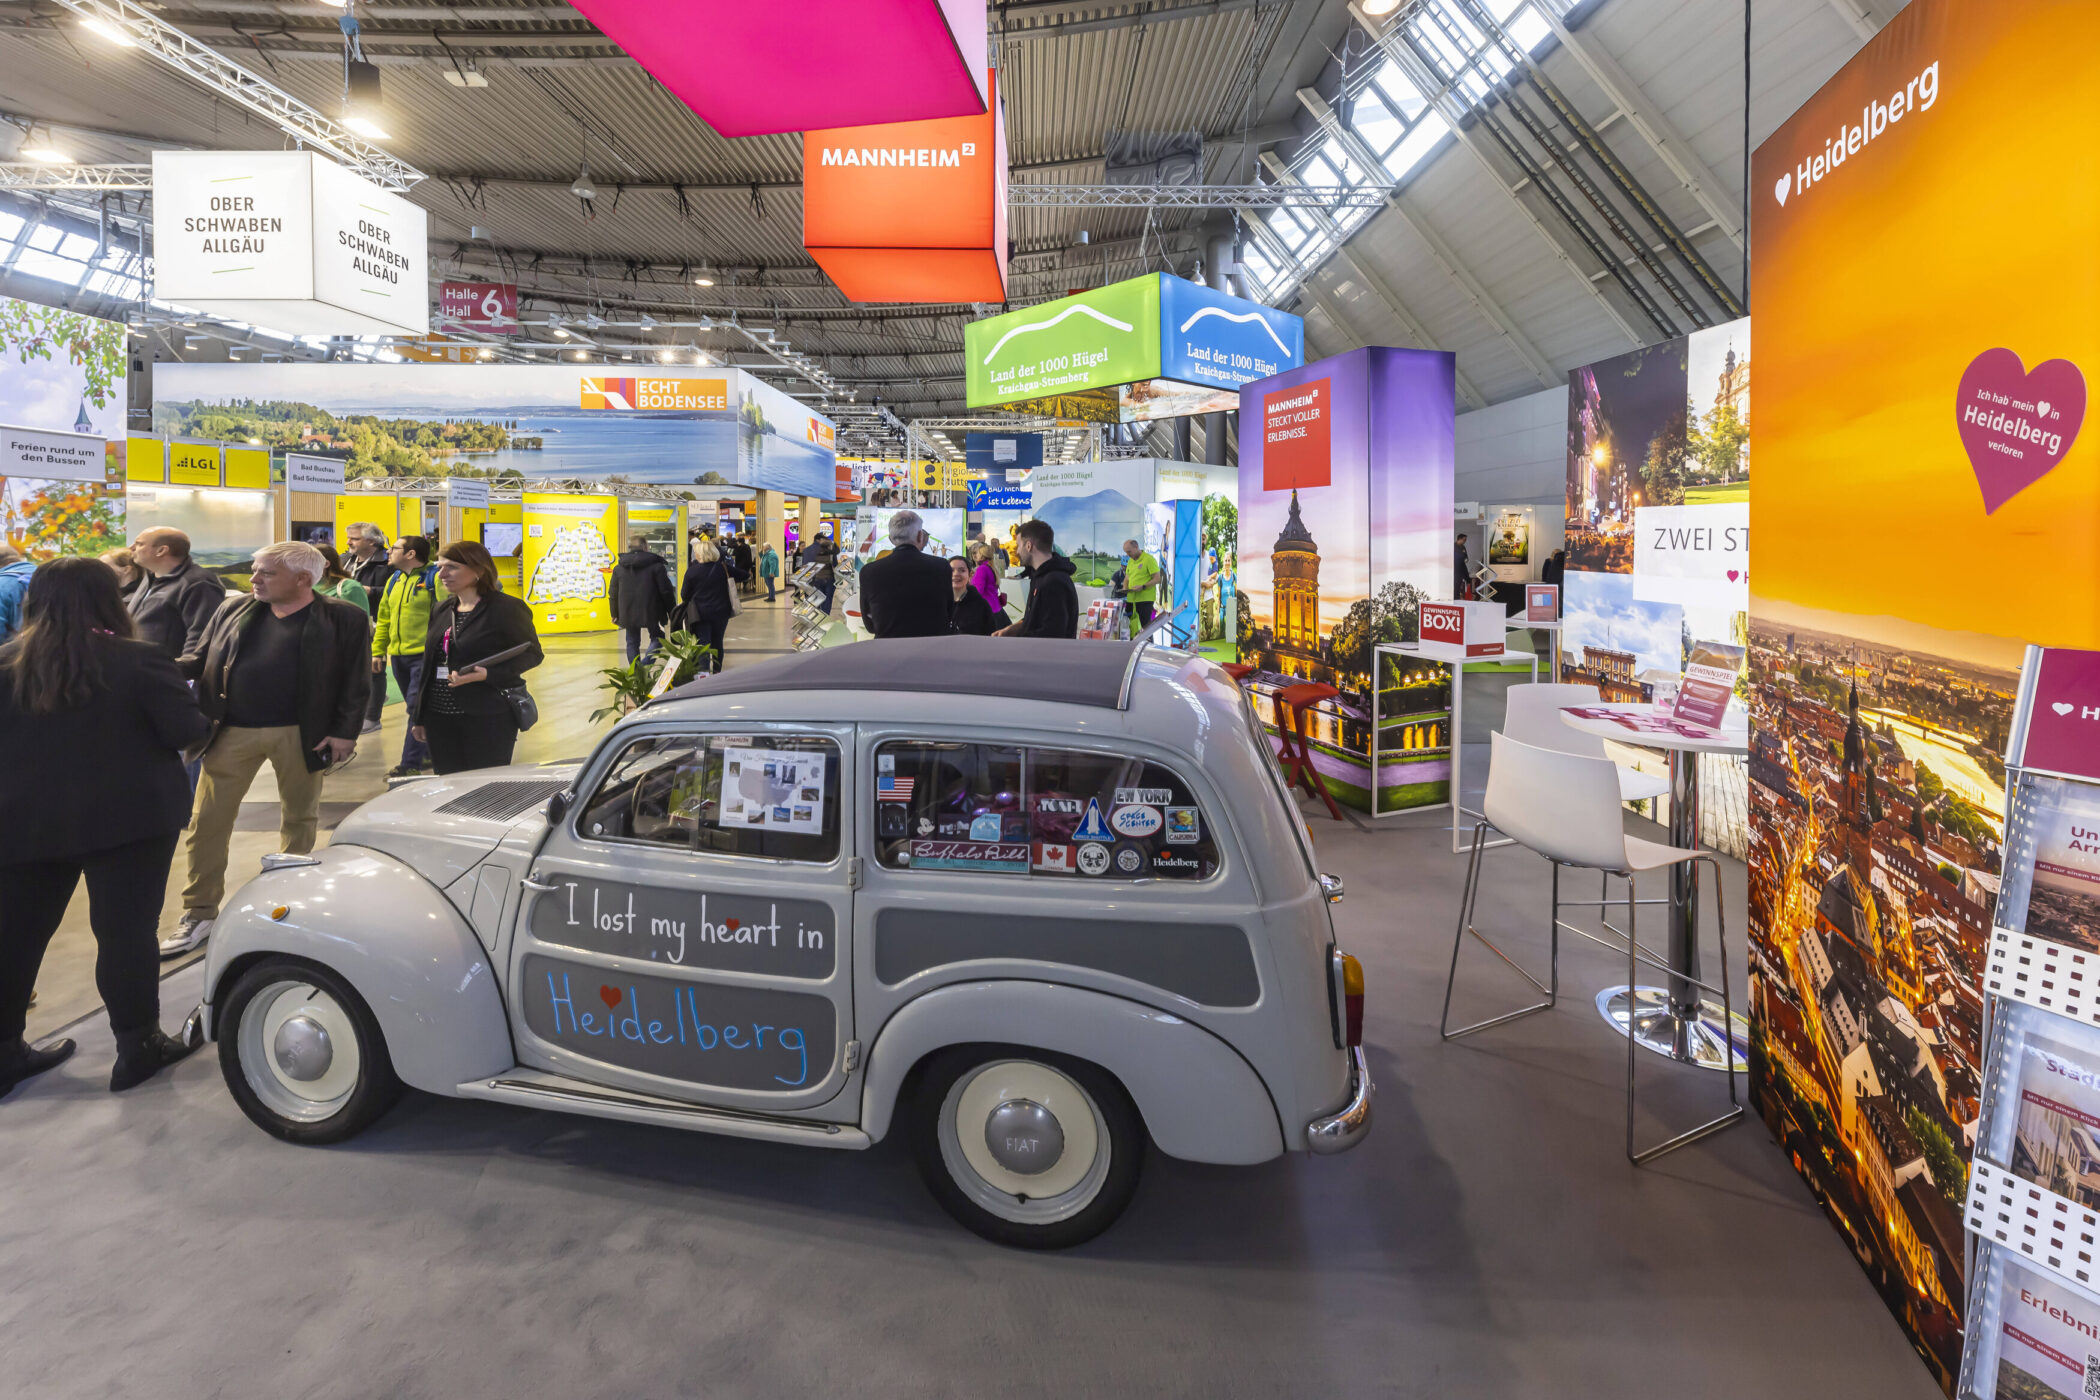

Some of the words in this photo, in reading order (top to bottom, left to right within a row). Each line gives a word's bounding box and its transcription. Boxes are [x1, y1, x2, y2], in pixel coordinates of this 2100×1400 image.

[1796, 60, 1940, 196] Heidelberg
[210, 197, 254, 211] OBER
[184, 217, 282, 232] SCHWABEN
[358, 219, 391, 245] OBER
[202, 236, 265, 253] ALLGÄU
[338, 230, 409, 271] SCHWABEN
[353, 256, 398, 285] ALLGÄU
[445, 288, 479, 300] Halle
[480, 289, 503, 318] 6
[446, 305, 471, 317] Hall
[990, 367, 1015, 384] Land
[1018, 364, 1036, 379] der
[1039, 357, 1069, 375] 1000
[1072, 347, 1109, 368] Hügel
[1187, 341, 1210, 360] Land
[1213, 348, 1228, 363] der
[1230, 352, 1252, 369] 1000
[1254, 357, 1277, 376] Hügel
[1194, 362, 1260, 383] Kraichgau-Stromb
[639, 380, 681, 394] ECHT
[997, 371, 1089, 396] Kraichgau-Stromberg
[639, 395, 725, 409] BODENSEE
[1977, 388, 1991, 400] Ich
[2011, 399, 2035, 413] mein
[2050, 408, 2060, 420] in
[1267, 414, 1292, 429] STECKT
[1293, 408, 1320, 423] VOLLER
[1267, 426, 1308, 443] ERLEBNISSE.
[1963, 404, 2062, 456] Heidelberg
[11, 441, 46, 453] Ferien
[50, 446, 75, 456] rund
[1988, 440, 2024, 459] verloren
[21, 453, 43, 462] den
[46, 454, 86, 466] Bussen
[190, 457, 216, 470] LGL
[988, 496, 999, 505] ist
[1654, 528, 1713, 550] ZWEI
[1423, 607, 1460, 616] GEWINNSPIEL
[1423, 613, 1460, 631] BOX!
[1689, 666, 1734, 680] GEWINNSPIEL
[1138, 790, 1171, 804] YORK
[1120, 810, 1146, 824] SPACE
[1125, 819, 1156, 828] CENTER
[1152, 858, 1199, 869] Heidelberg
[2039, 863, 2051, 871] Mit
[565, 882, 580, 926] I
[593, 887, 637, 935] lost
[651, 916, 685, 964] my
[701, 894, 781, 947] heart
[798, 922, 823, 949] in
[547, 972, 808, 1086] Heidelberg
[2055, 1104, 2078, 1118] einem
[2080, 1115, 2099, 1125] Klick
[1005, 1137, 1040, 1153] FIAT
[2020, 1288, 2100, 1342] Erlebni
[2022, 1336, 2035, 1346] nur
[2036, 1344, 2060, 1360] einem
[2061, 1357, 2081, 1371] Klick
